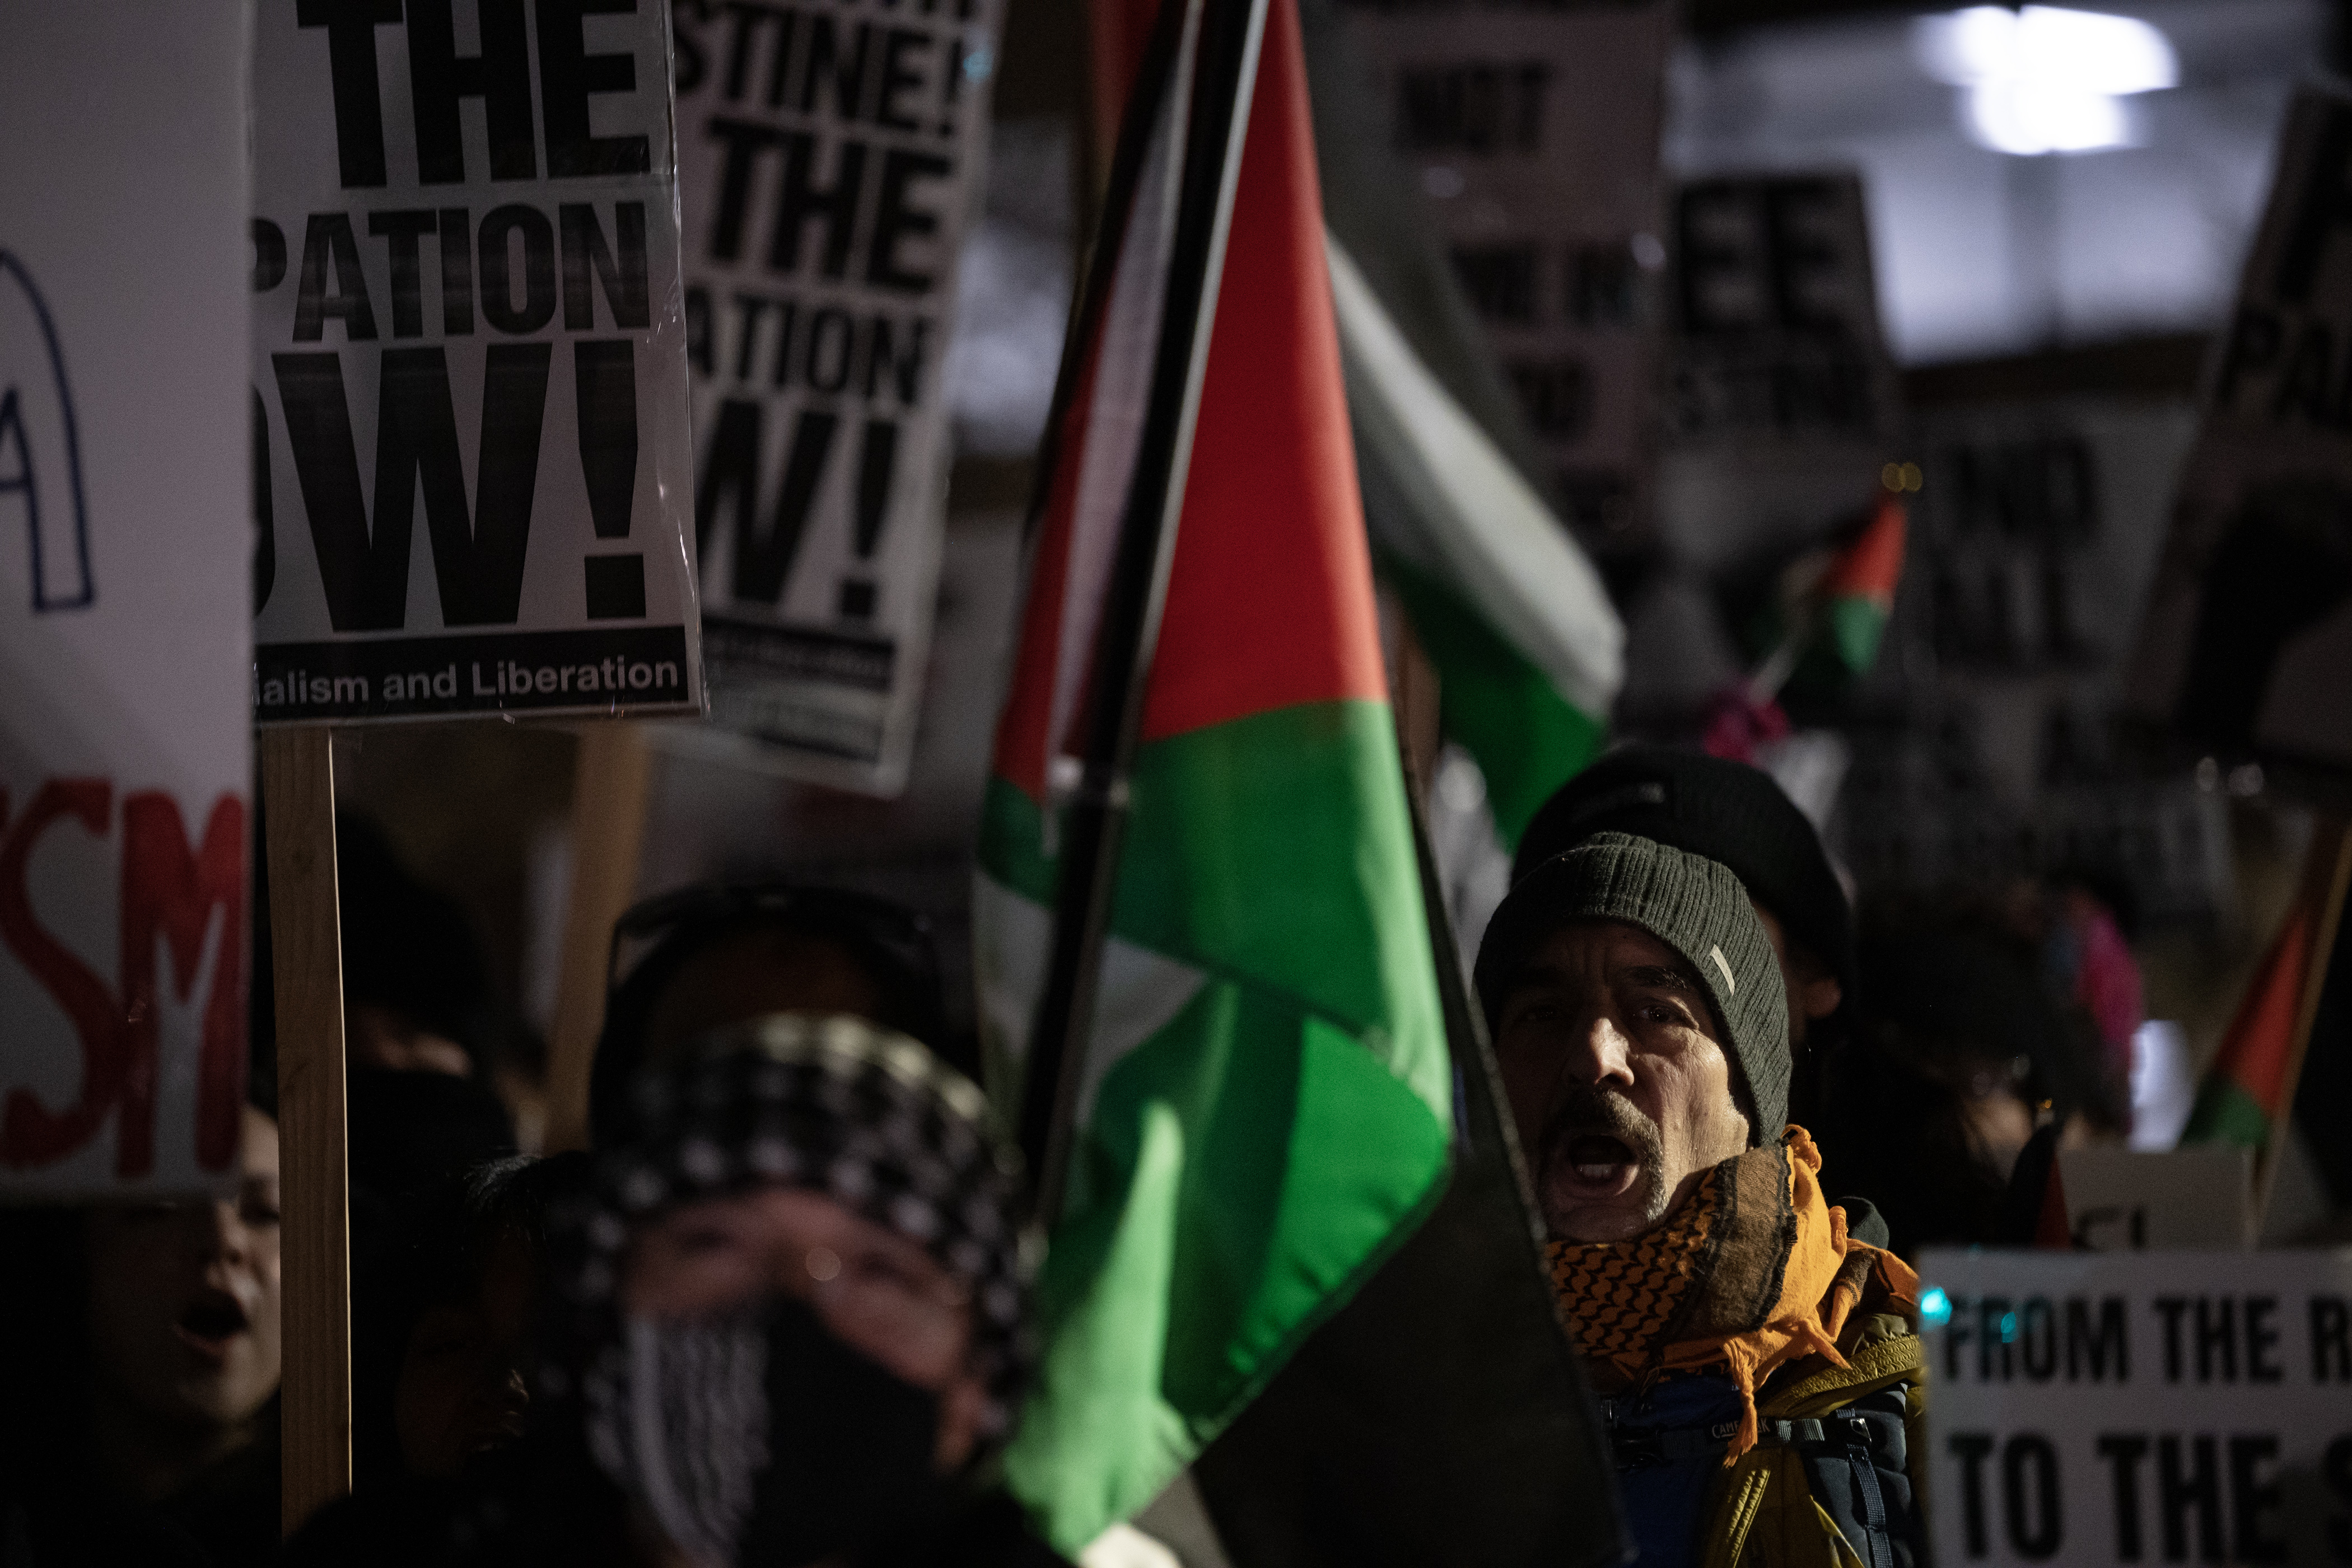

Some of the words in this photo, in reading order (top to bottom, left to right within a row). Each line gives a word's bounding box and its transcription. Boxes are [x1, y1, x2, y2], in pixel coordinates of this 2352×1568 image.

[297, 0, 651, 189] THE
[709, 115, 953, 296] THE
[252, 339, 647, 632] W!
[255, 669, 370, 707] alism
[383, 661, 458, 700] and
[472, 654, 680, 698] Liberation
[0, 777, 244, 1178] SM
[1945, 1295, 2129, 1383] FROM
[2155, 1295, 2283, 1383] THE
[1948, 1431, 2062, 1560] TO
[2097, 1432, 2288, 1562] THE
